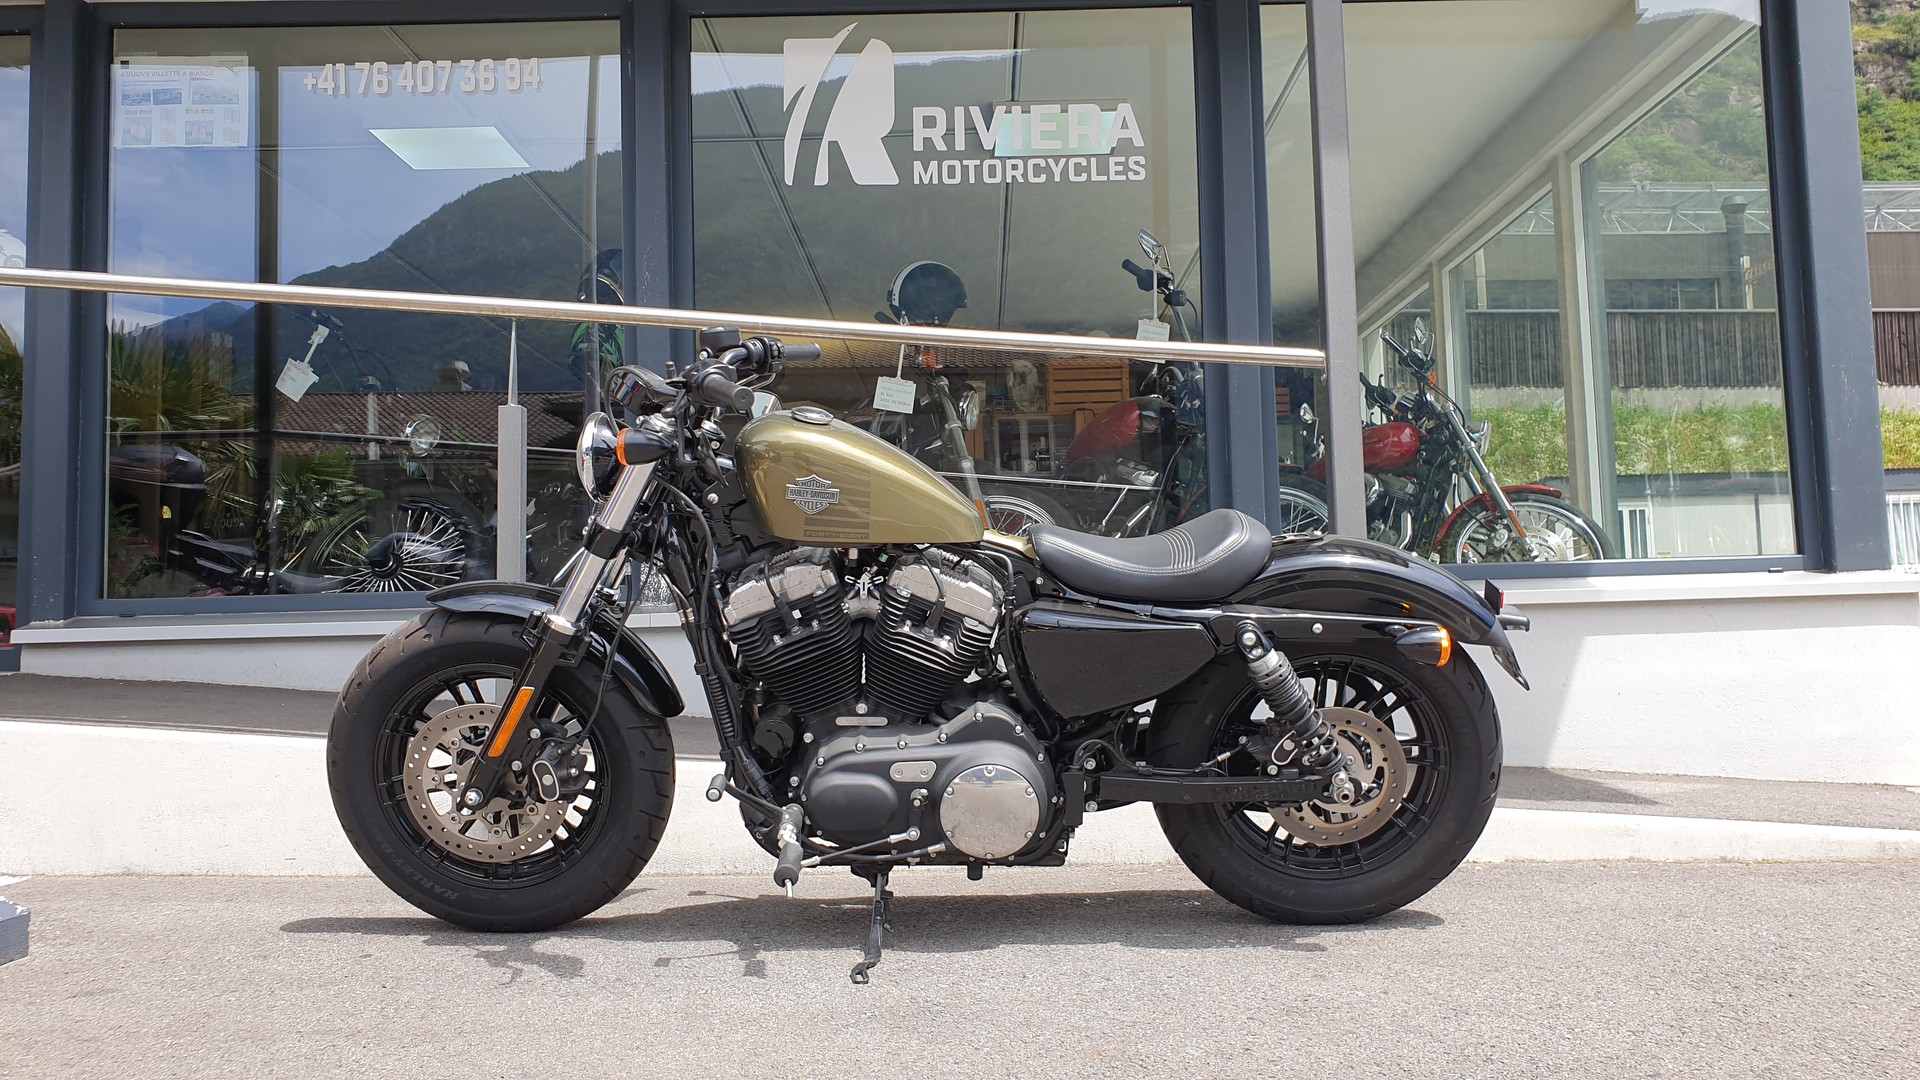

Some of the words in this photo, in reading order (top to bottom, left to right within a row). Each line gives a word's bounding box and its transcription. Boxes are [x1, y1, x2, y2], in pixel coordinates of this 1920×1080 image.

[303, 62, 346, 95] +41
[354, 61, 389, 94] 76
[397, 60, 452, 93] 407
[459, 58, 495, 92] 36
[504, 57, 541, 91] 94
[912, 102, 1145, 152] RIVIERA
[913, 156, 1146, 185] MOTORCYCLES
[789, 488, 836, 500] HARLEY-DAVIDSON
[801, 481, 826, 489] MOTOR
[799, 500, 824, 511] CYCLES
